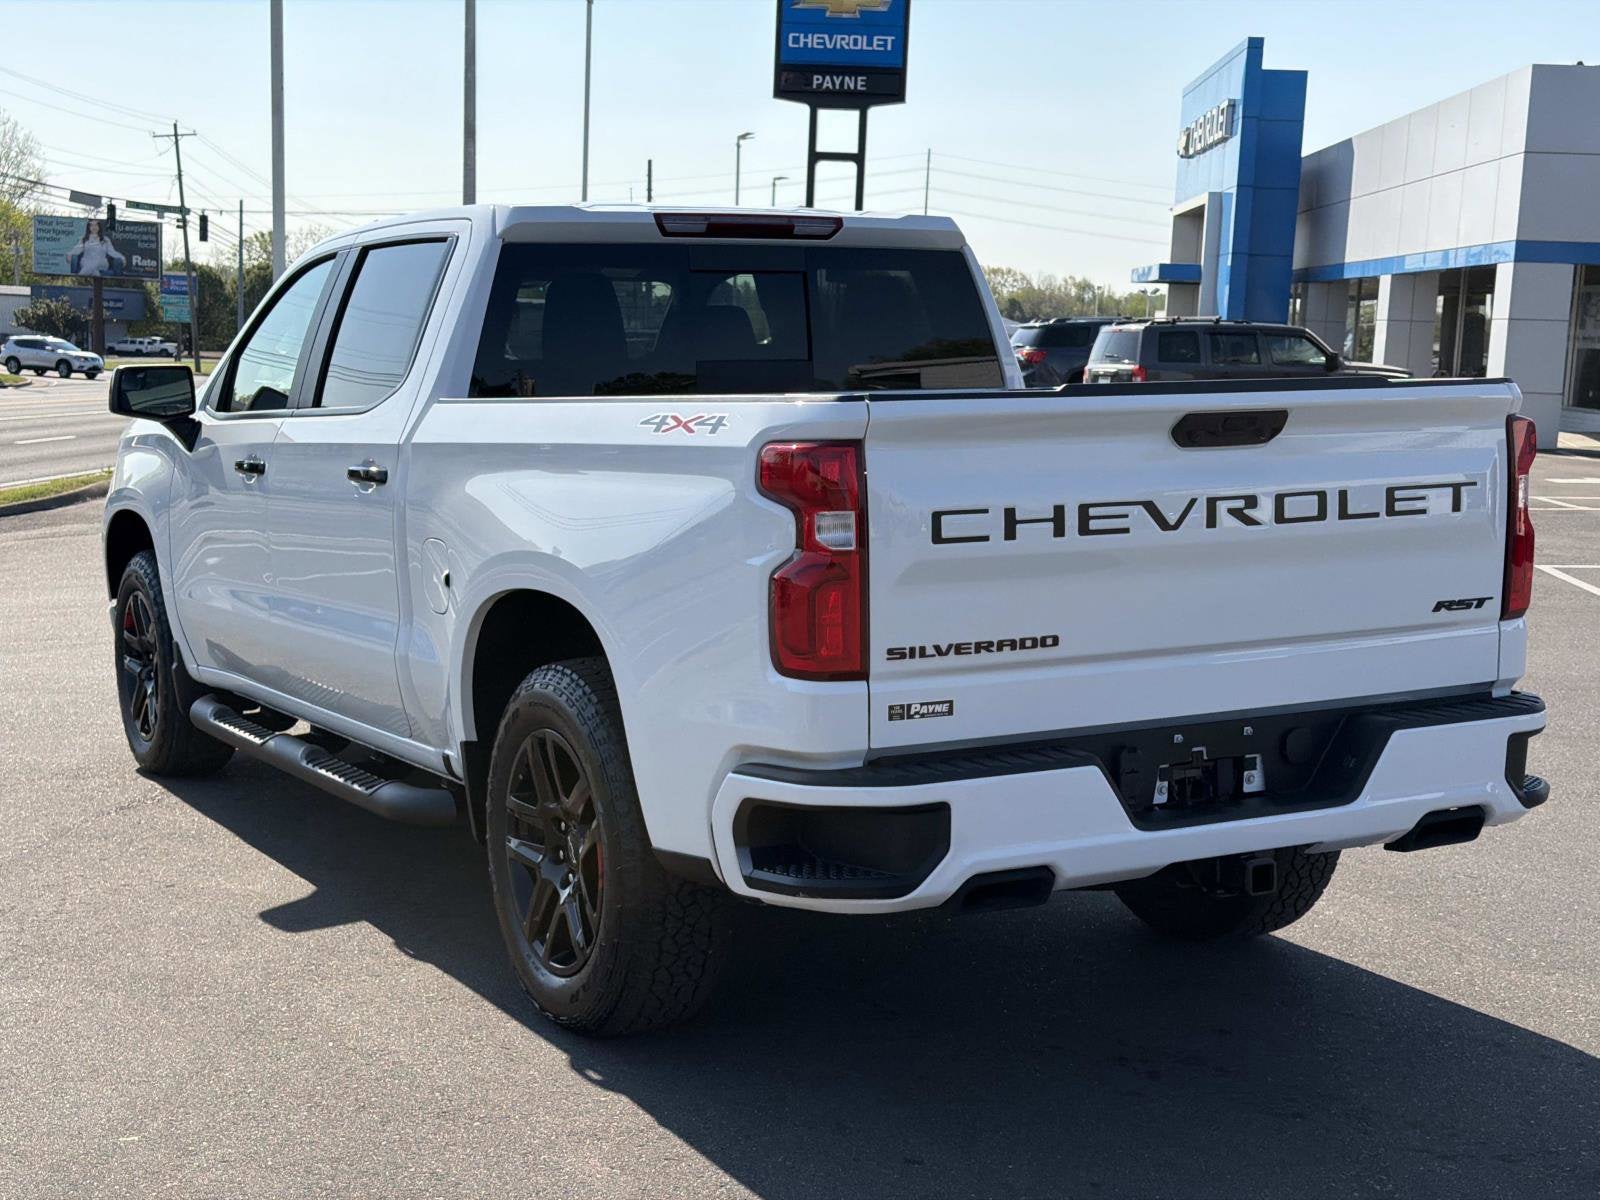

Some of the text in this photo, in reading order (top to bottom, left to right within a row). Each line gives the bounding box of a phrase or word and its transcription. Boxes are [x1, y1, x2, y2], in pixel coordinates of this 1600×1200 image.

[787, 32, 896, 51] CHEVROLET
[812, 74, 868, 91] PAYNE
[132, 255, 158, 267] Rate
[930, 481, 1478, 545] CHEVROLET
[1431, 596, 1494, 613] RST
[886, 634, 1060, 661] SILVERADO
